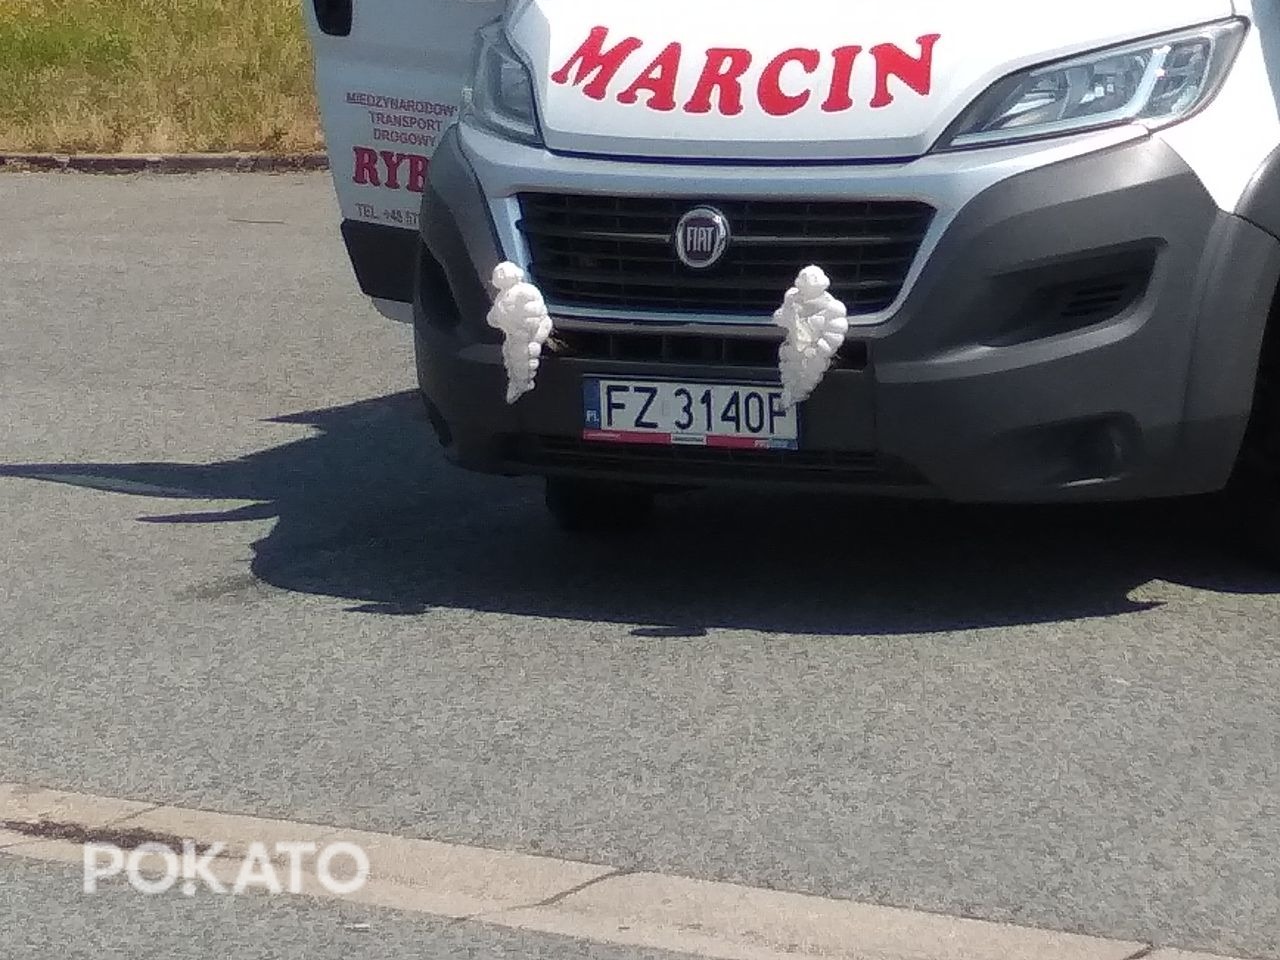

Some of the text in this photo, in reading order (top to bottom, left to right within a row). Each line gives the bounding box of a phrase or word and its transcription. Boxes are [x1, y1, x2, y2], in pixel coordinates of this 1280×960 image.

[551, 25, 941, 116] MARCIN
[368, 110, 443, 132] TRANSPORT
[373, 127, 436, 147] DROGOWY
[352, 145, 430, 193] RYB
[686, 226, 715, 252] FIAT
[606, 384, 787, 434] FZ 3140F
